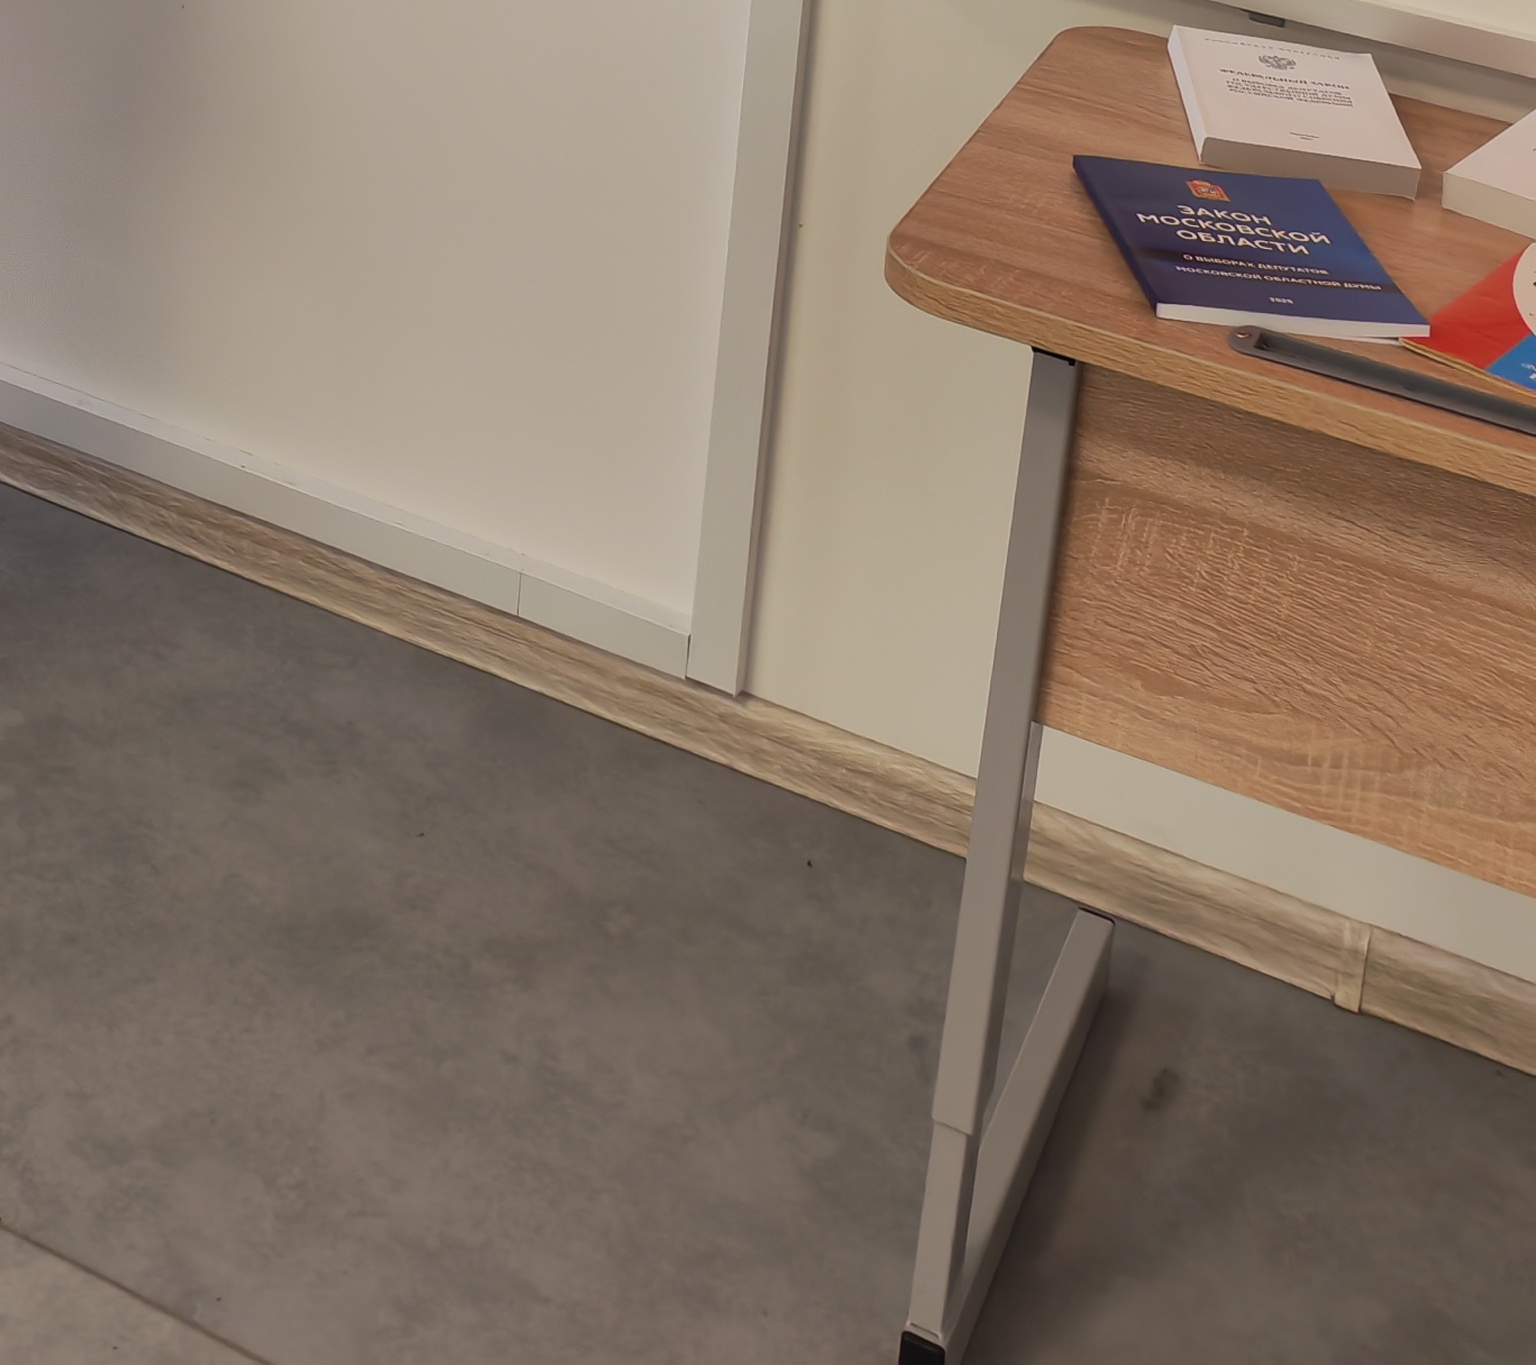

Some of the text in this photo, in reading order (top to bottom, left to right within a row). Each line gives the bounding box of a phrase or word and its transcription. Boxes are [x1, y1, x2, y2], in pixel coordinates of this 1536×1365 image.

[1176, 204, 1272, 226] ЗАКОН
[1136, 212, 1333, 245] МОСКОВСКОЙ
[1176, 229, 1310, 255] ОБЛАСТИ
[1175, 265, 1382, 291] МОСКОВСКОЙ ОБЛАСТНОЙ ДУМЫ
[1196, 255, 1256, 269] ВЫБОРАХ
[1258, 263, 1330, 275] ДЕПУТАТОВ
